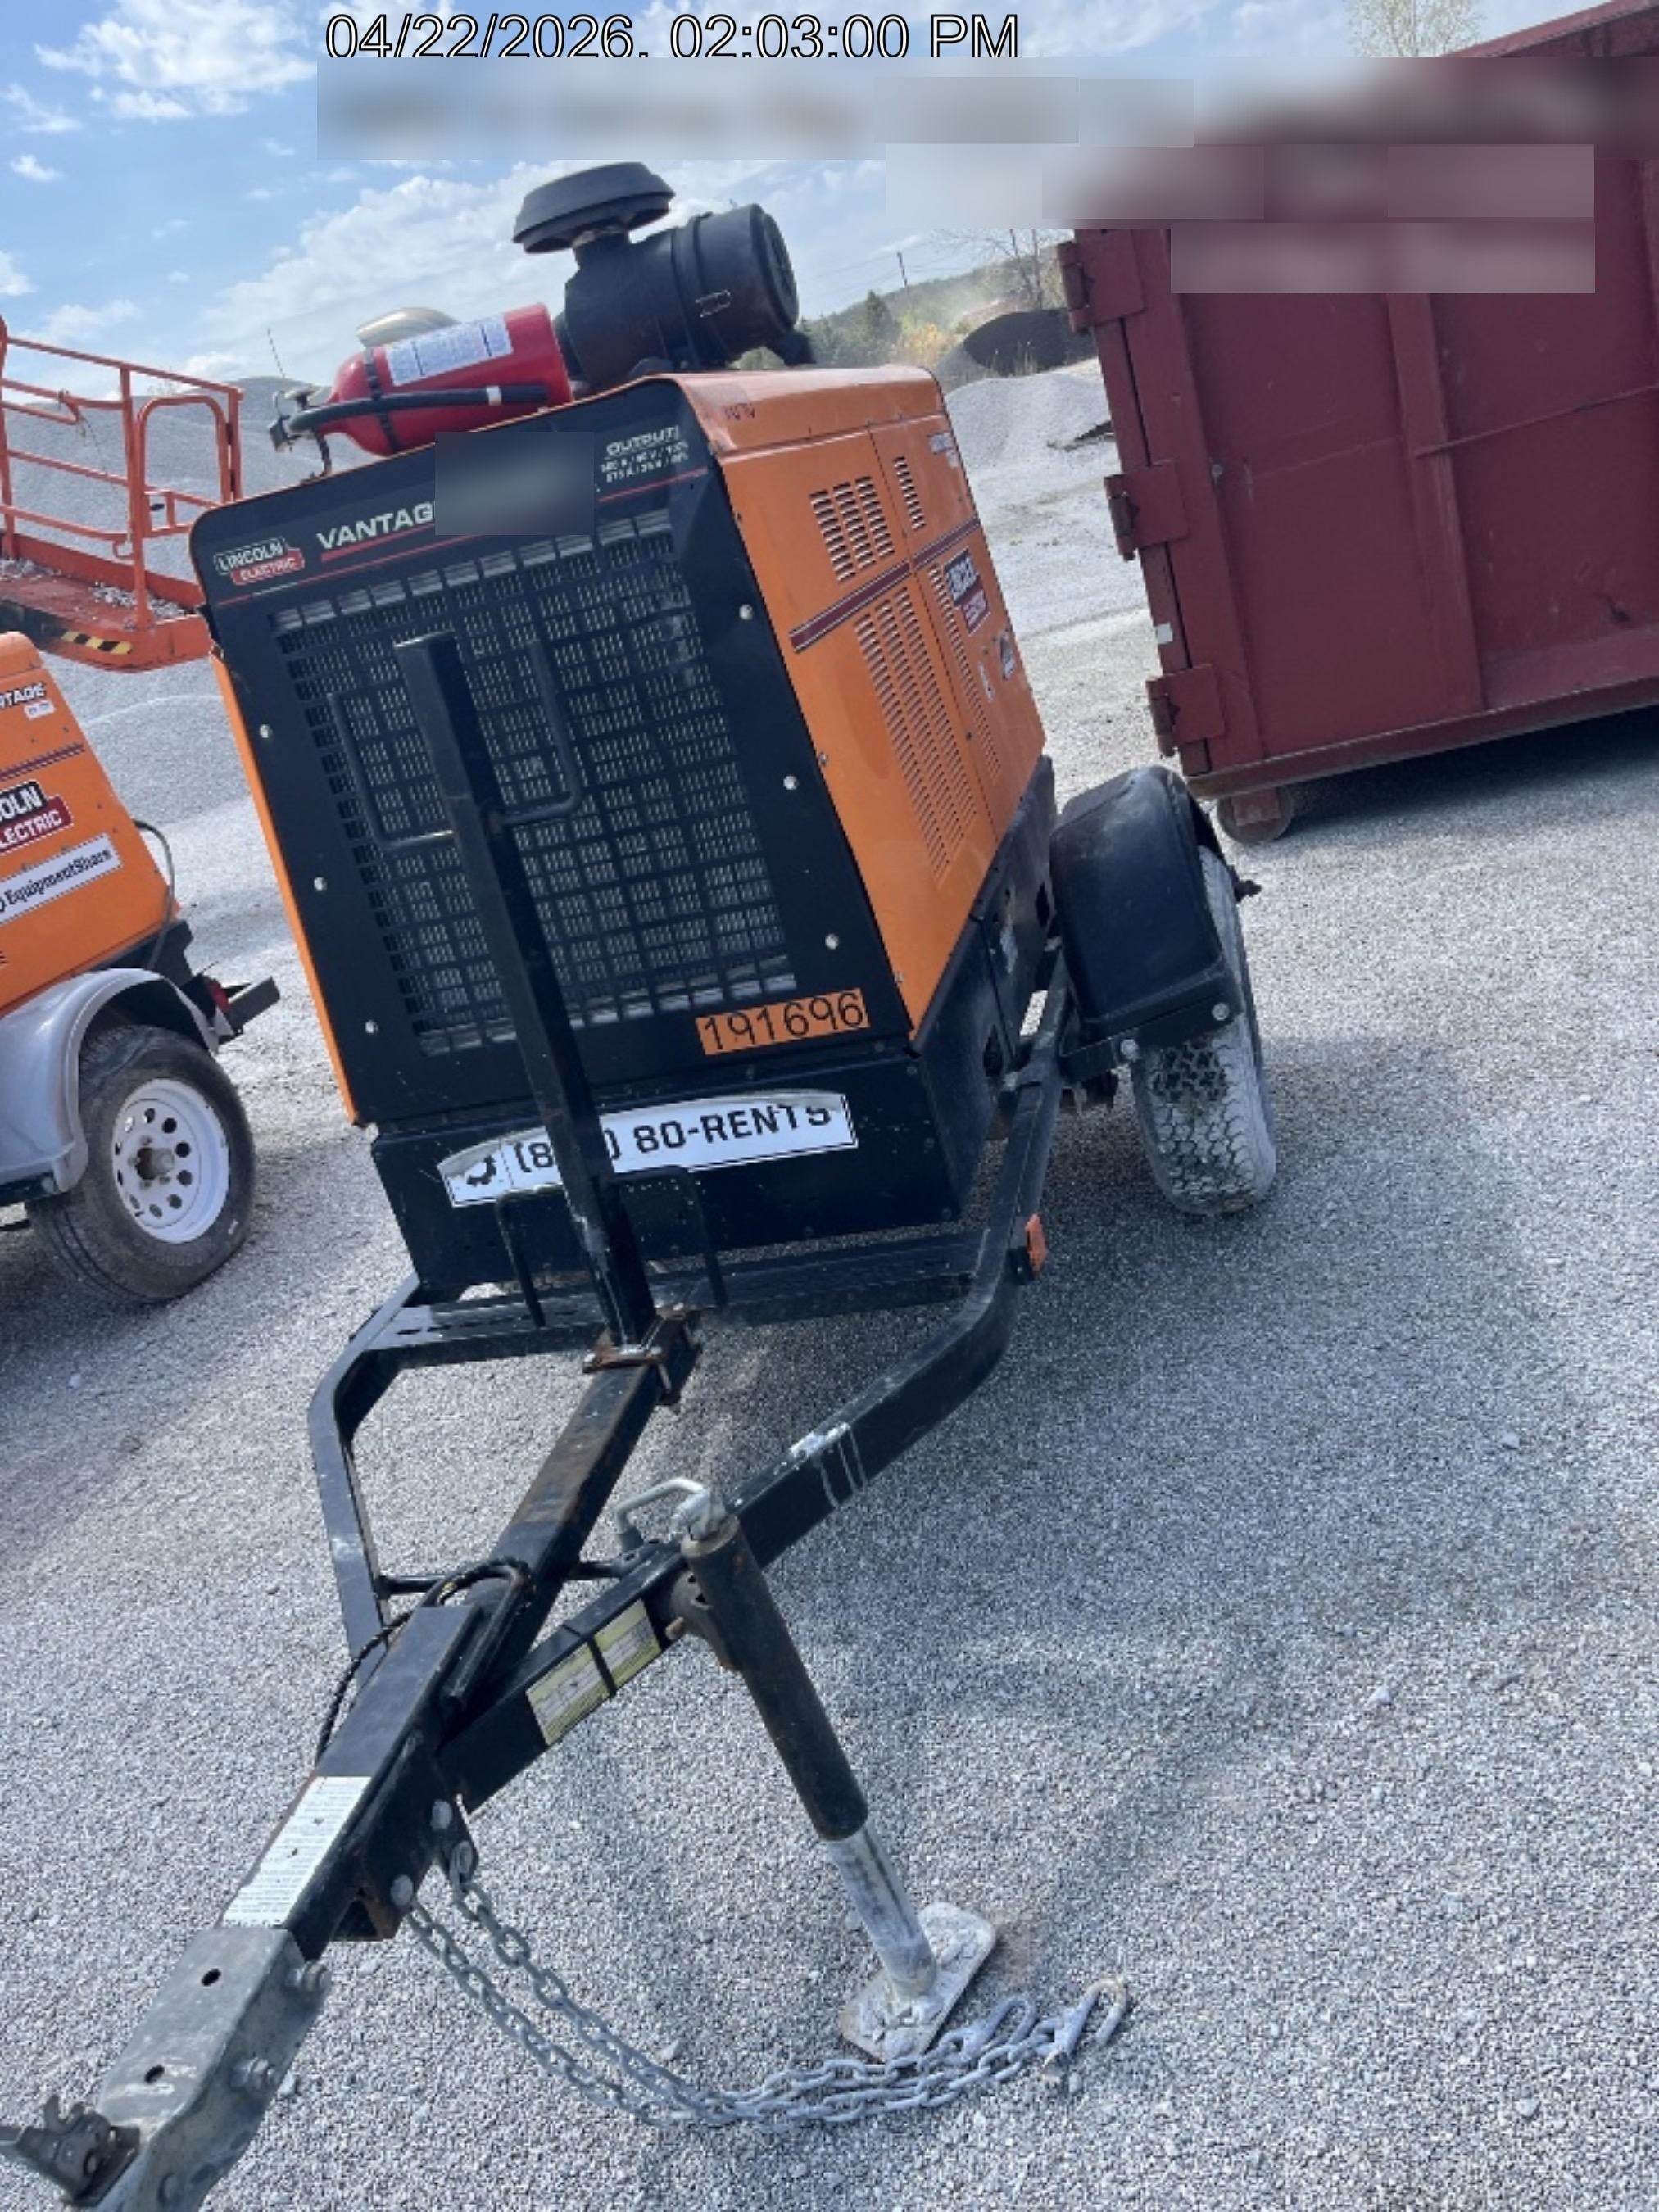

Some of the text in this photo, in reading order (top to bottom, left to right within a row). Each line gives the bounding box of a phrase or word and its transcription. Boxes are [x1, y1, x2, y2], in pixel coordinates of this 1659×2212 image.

[315, 501, 436, 549] VANTAG
[217, 542, 283, 572] LINCOLN
[0, 786, 43, 822] OLN
[4, 849, 112, 905] EquipmentShare
[705, 992, 864, 1050] 191696
[513, 1103, 832, 1173] (8) 80-RENTS
